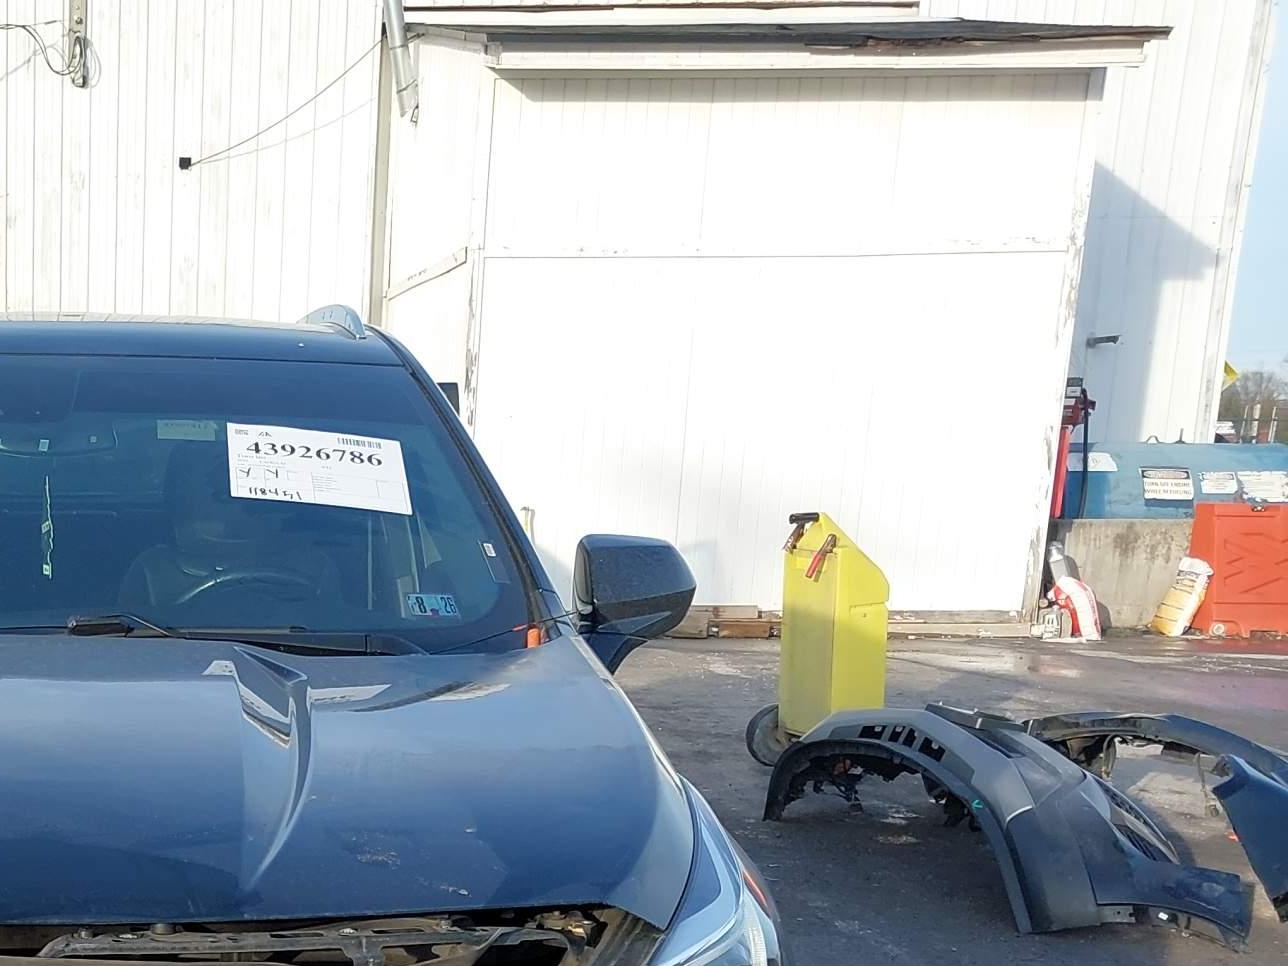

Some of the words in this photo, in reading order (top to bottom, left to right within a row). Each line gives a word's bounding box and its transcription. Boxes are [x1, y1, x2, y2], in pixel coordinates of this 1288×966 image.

[246, 441, 383, 467] 43926786
[415, 596, 427, 614] 8
[440, 596, 457, 614] 26
